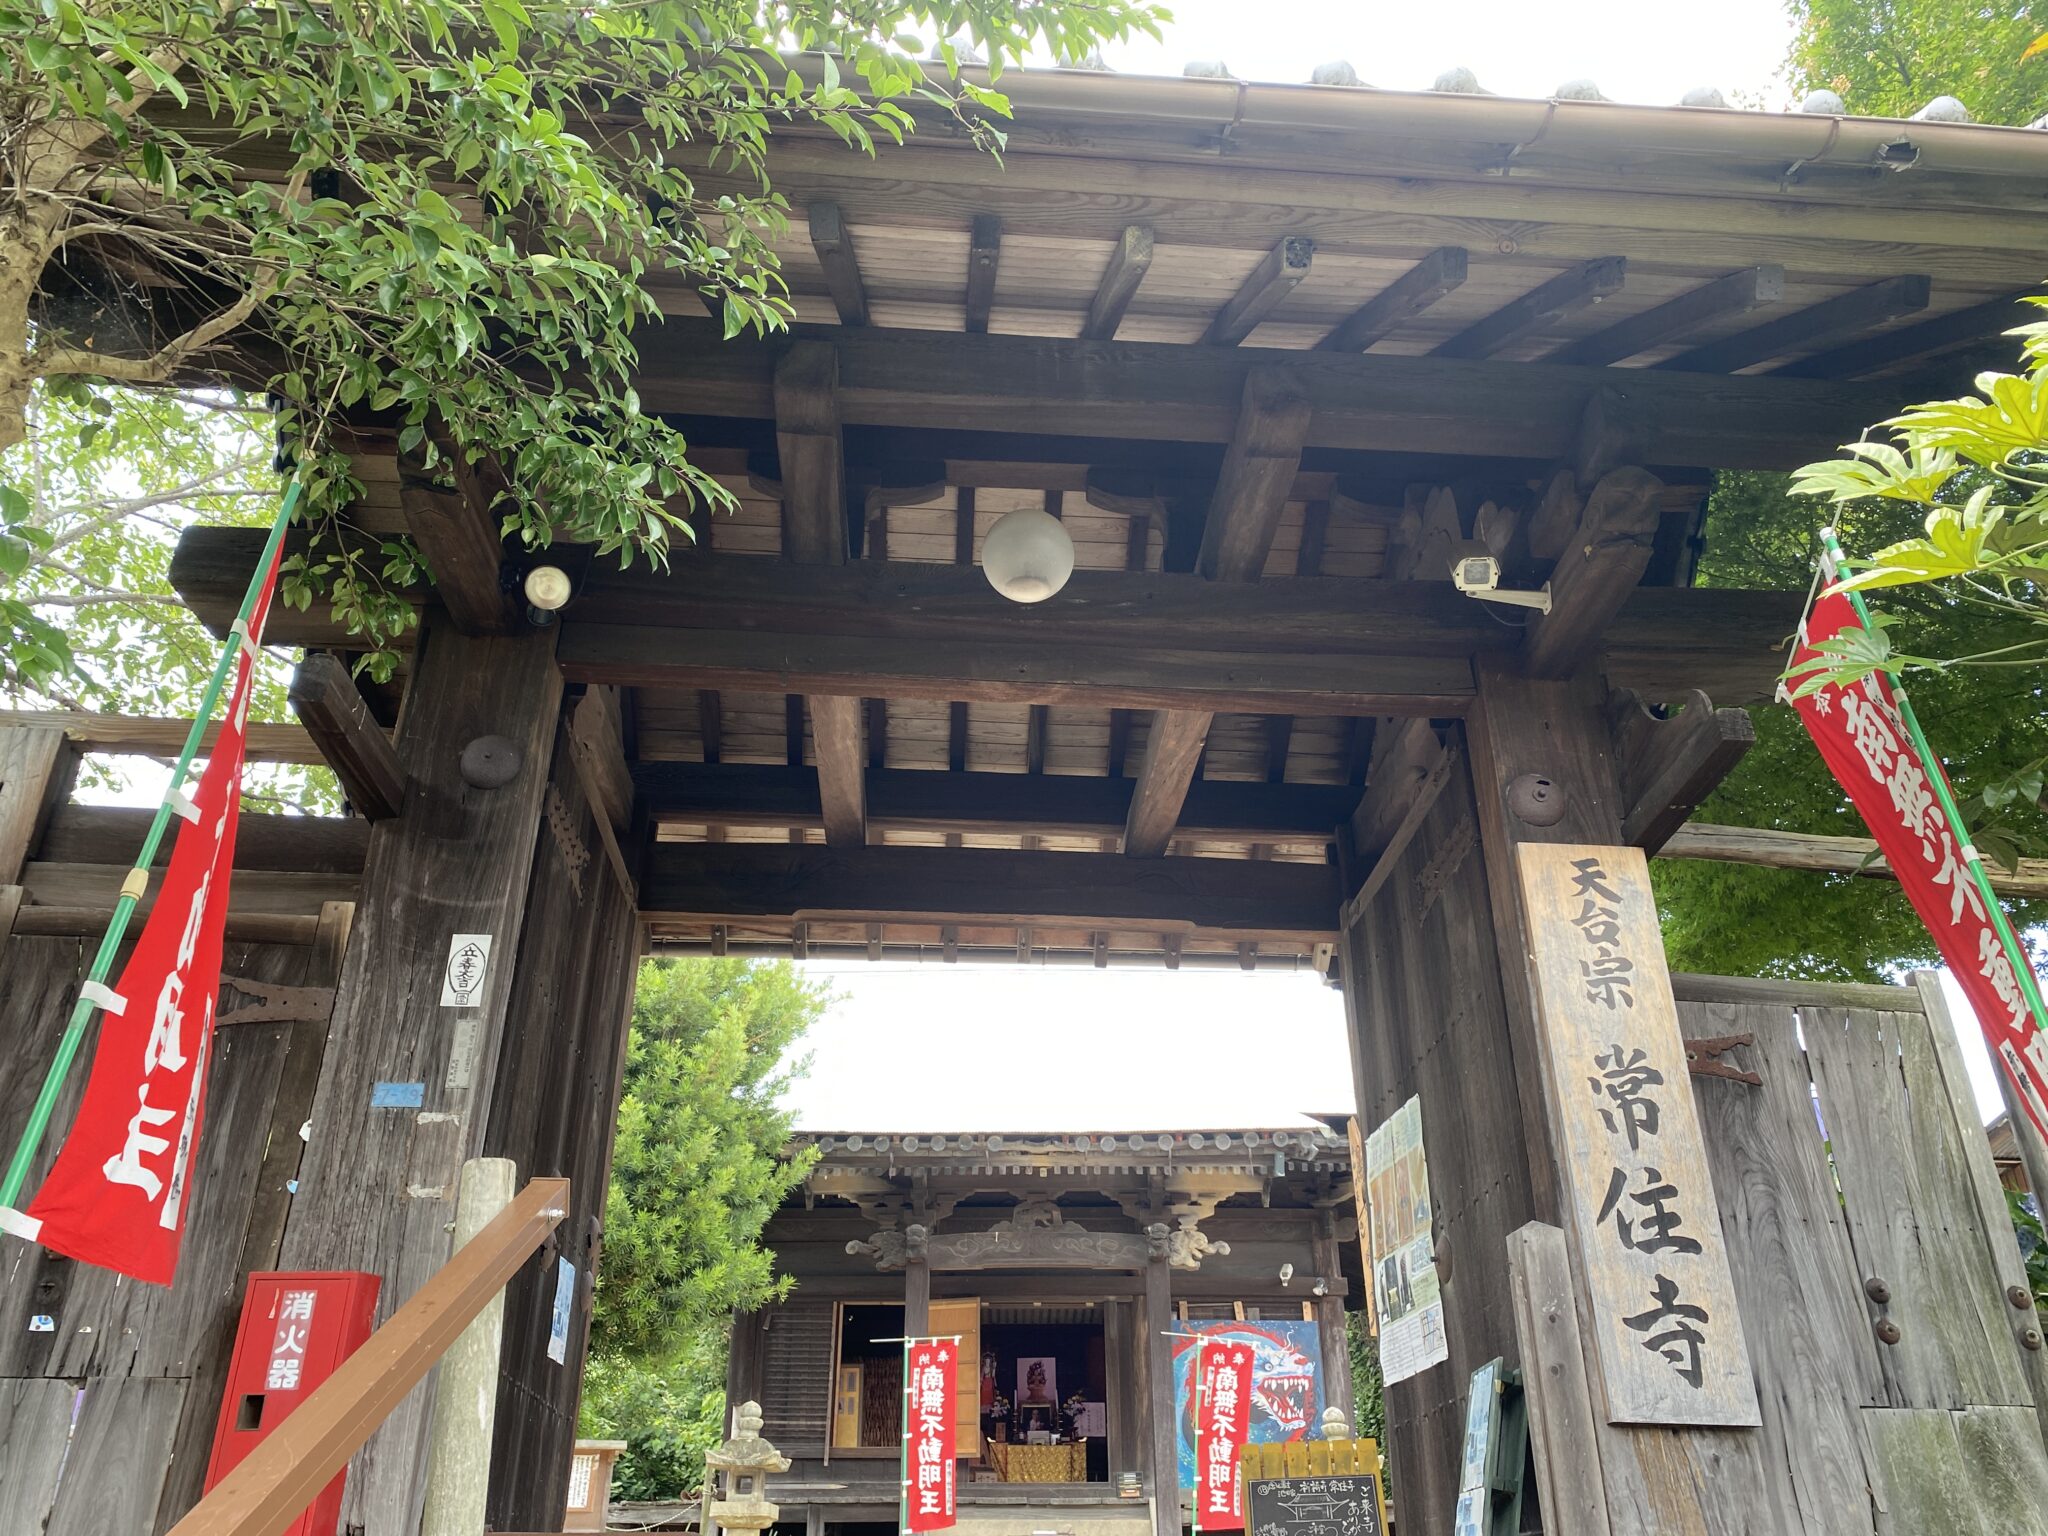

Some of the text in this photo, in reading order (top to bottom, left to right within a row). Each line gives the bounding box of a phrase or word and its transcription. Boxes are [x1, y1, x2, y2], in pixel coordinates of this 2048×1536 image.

[1569, 857, 1710, 1391] 天台宗 常住寺
[267, 1291, 316, 1390] 消火器
